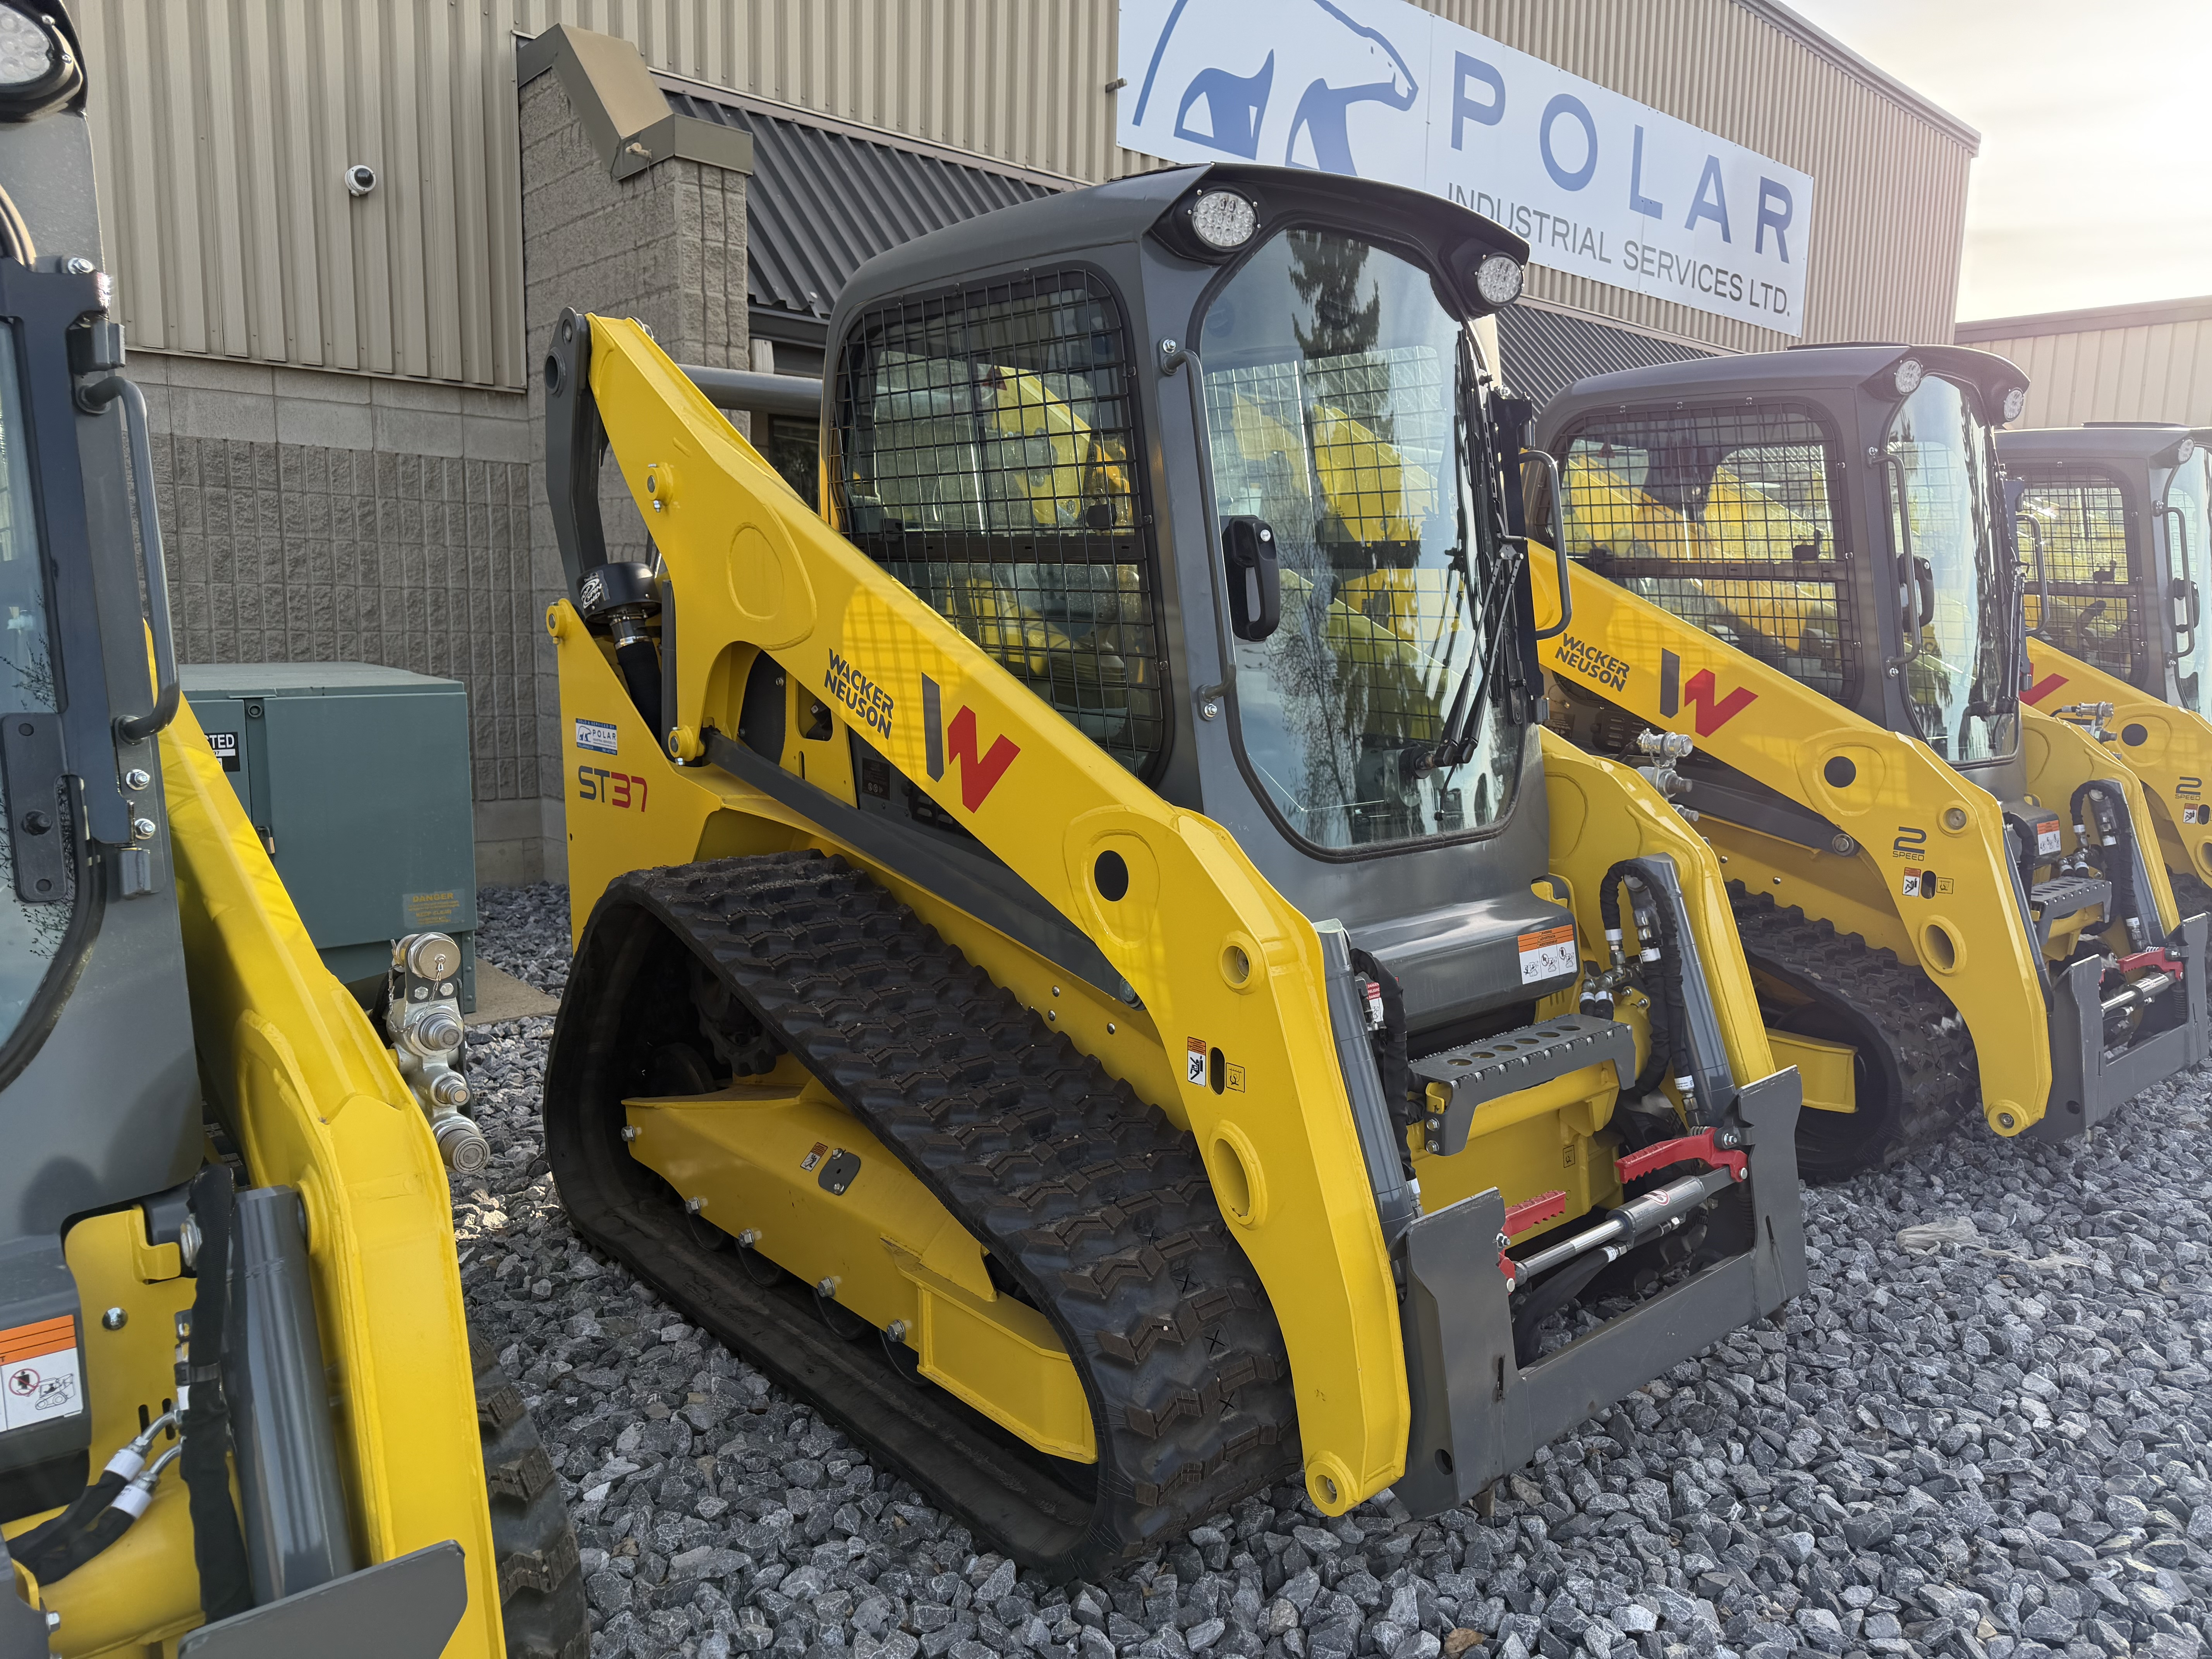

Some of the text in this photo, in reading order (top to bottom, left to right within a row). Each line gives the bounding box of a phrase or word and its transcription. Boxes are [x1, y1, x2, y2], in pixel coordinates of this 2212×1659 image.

[1451, 50, 1793, 264] POLAR
[1448, 182, 1790, 317] INDUSTRIAL SERVICES LTD.
[1555, 646, 1626, 692] NEUSON
[1563, 632, 1630, 679] WACKER
[824, 669, 892, 740] NEUSON
[829, 647, 894, 720] WACKER
[204, 734, 235, 749] TED
[592, 729, 616, 741] POLAR
[578, 765, 647, 812] ST37
[2176, 776, 2202, 796] 2
[1893, 826, 1927, 854] 2
[1893, 850, 1925, 862] SPEED
[412, 892, 453, 903] DANGER
